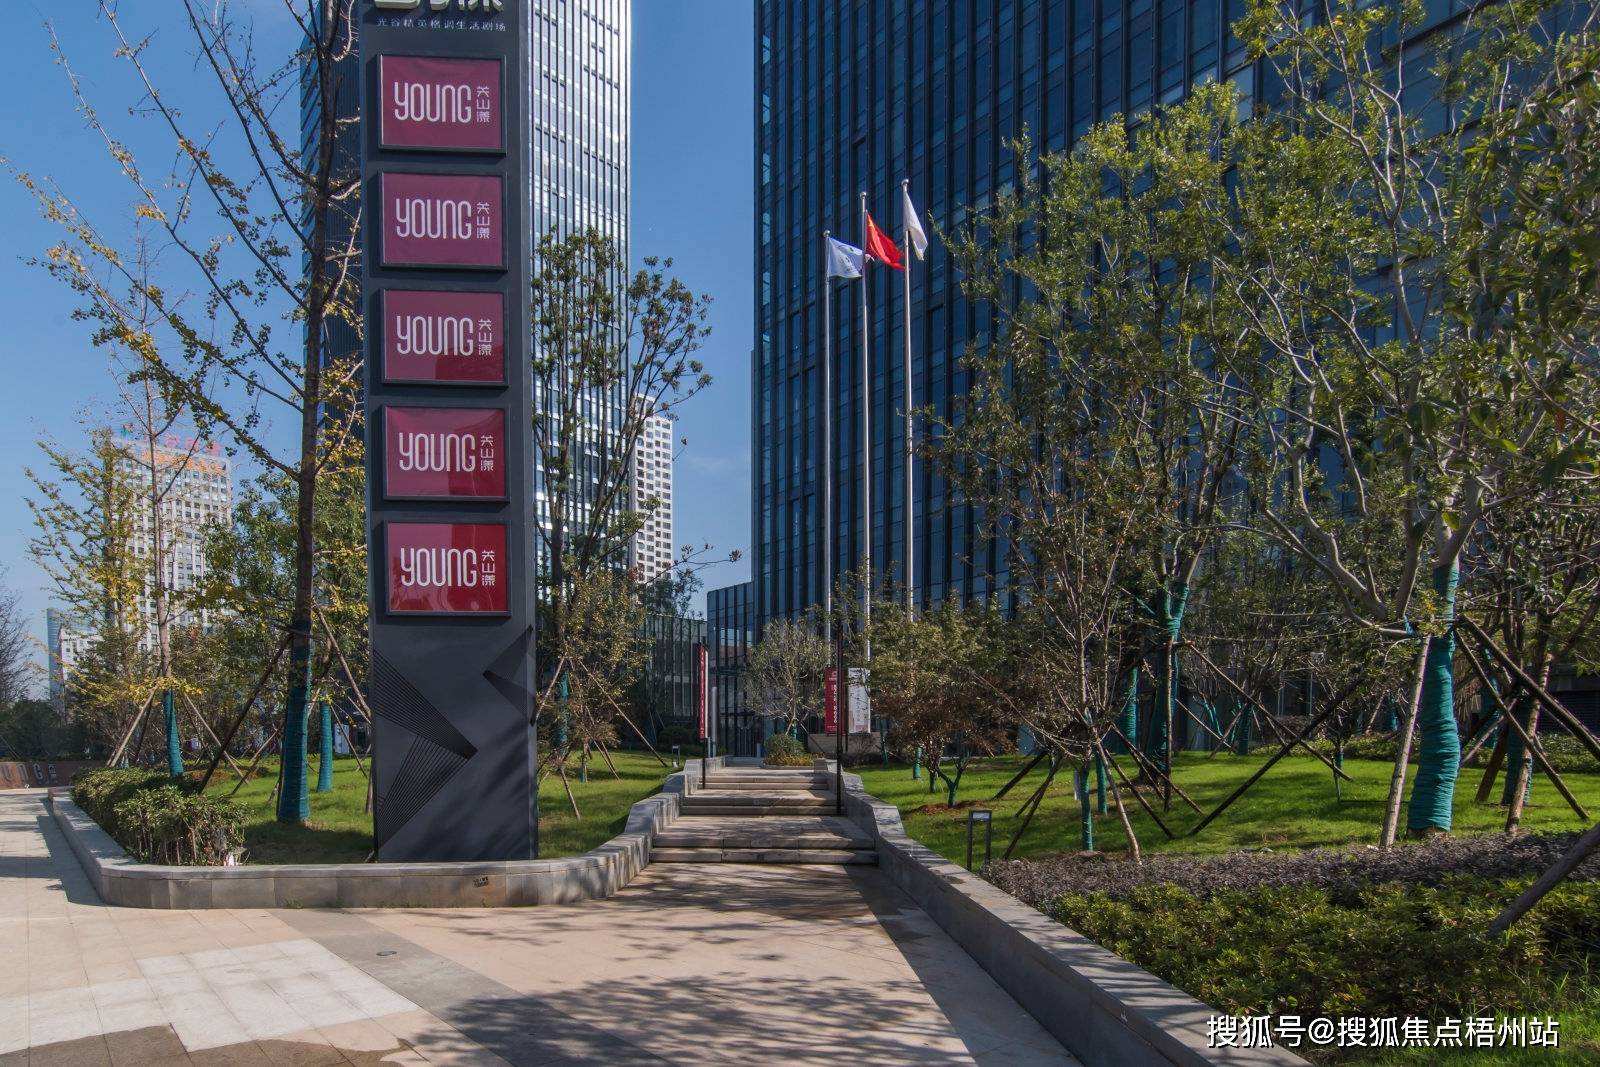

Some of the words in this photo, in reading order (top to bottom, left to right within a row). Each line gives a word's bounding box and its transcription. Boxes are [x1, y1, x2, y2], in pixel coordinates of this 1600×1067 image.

[395, 82, 471, 122] YOUNG
[397, 199, 473, 239] YOUNG
[397, 316, 473, 355] YOUNG
[399, 433, 476, 471] YOUNG
[401, 548, 477, 586] YOUNG
